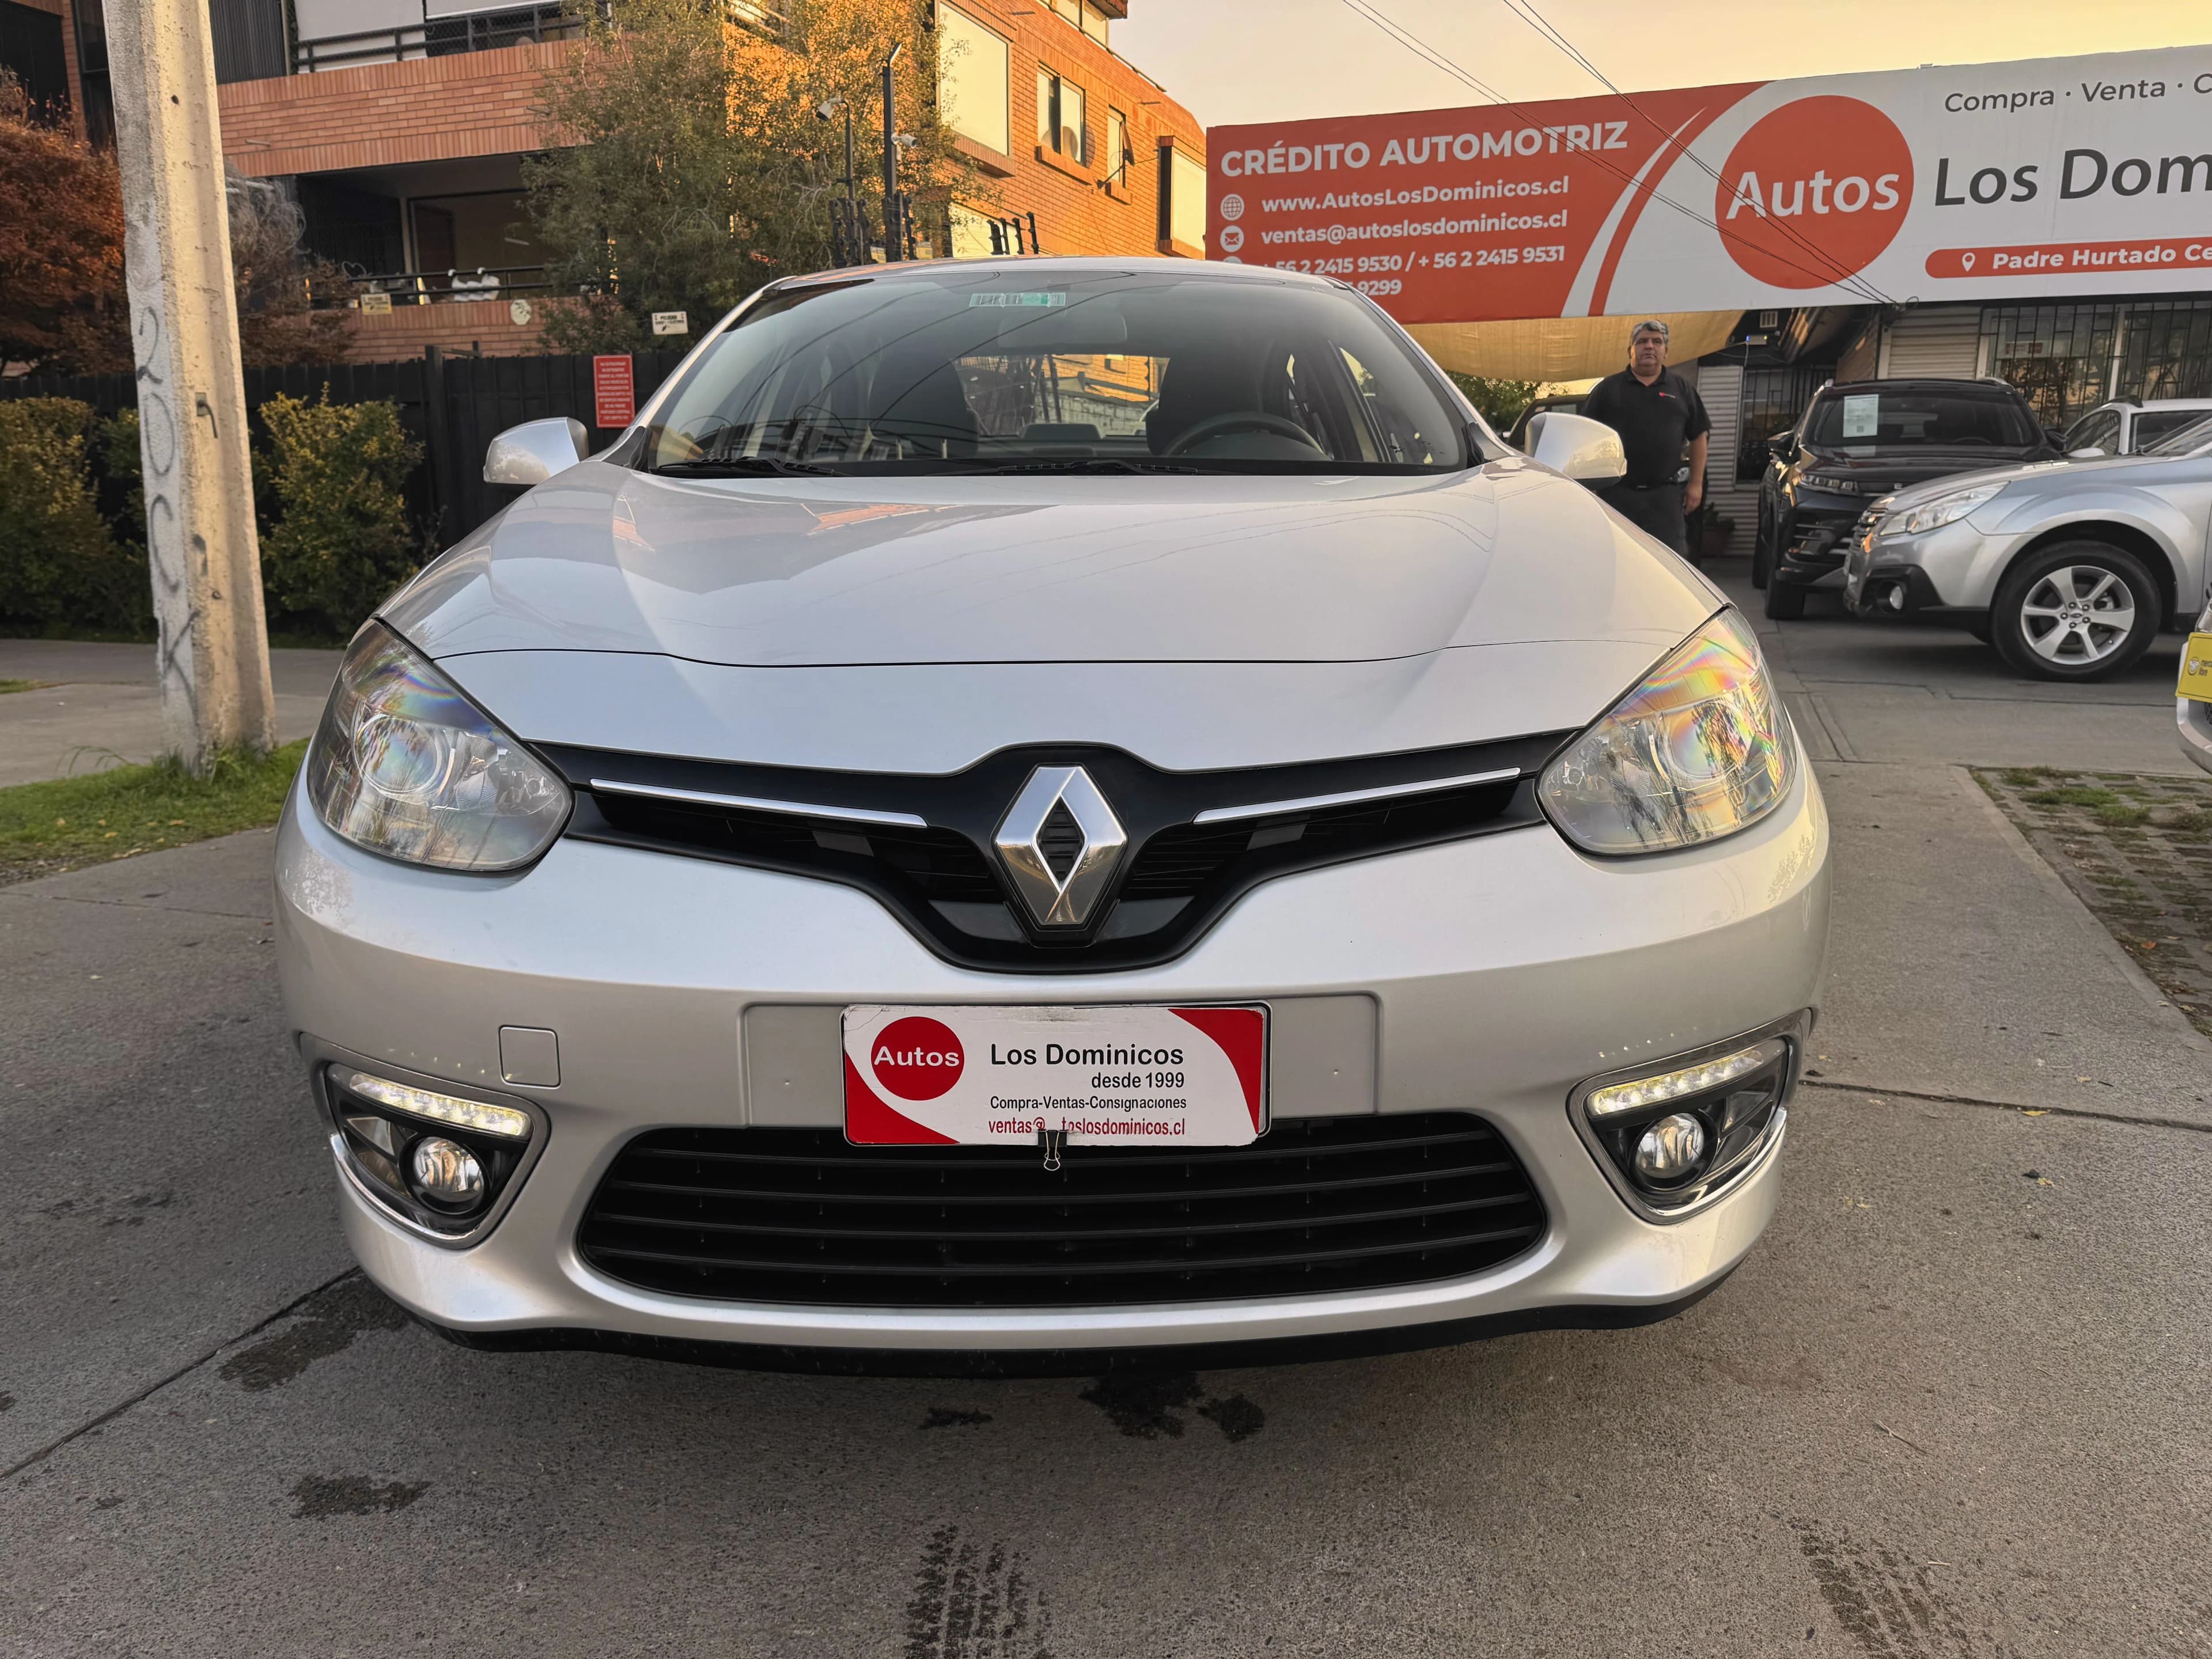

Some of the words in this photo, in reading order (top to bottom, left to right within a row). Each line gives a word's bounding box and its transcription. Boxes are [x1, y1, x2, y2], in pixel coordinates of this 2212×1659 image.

[1945, 87, 2055, 113] Compra
[2081, 79, 2165, 103] Venta
[1221, 140, 1370, 177] CRÉDITO
[1380, 121, 1628, 166] AUTOMOTRIZ
[1935, 157, 2038, 206] Los
[2059, 148, 2212, 200] Dom
[1262, 176, 1569, 213] www.AutosLosDominicos.cl
[1726, 169, 1899, 219] Autos
[1261, 209, 1567, 244] ventas@autoslosdominicos.cl
[1314, 257, 1354, 274] 2415
[1357, 255, 1402, 272] 9530
[1433, 252, 1457, 269] 56
[1460, 251, 1472, 267] 2
[1476, 248, 1518, 266] 2415
[1522, 246, 1565, 263] 9531
[1992, 251, 2063, 270] Padre
[2071, 244, 2176, 267] Hurtado
[873, 1046, 960, 1067] Autos
[991, 1043, 1037, 1066] Los
[1046, 1043, 1184, 1066] Dominicos
[1092, 1071, 1141, 1089] desde
[1146, 1071, 1185, 1089] 1999
[990, 1096, 1187, 1111] Compra-Ventas-Consignaciones
[988, 1116, 1185, 1135] ventas@toslosdominicos.cl
